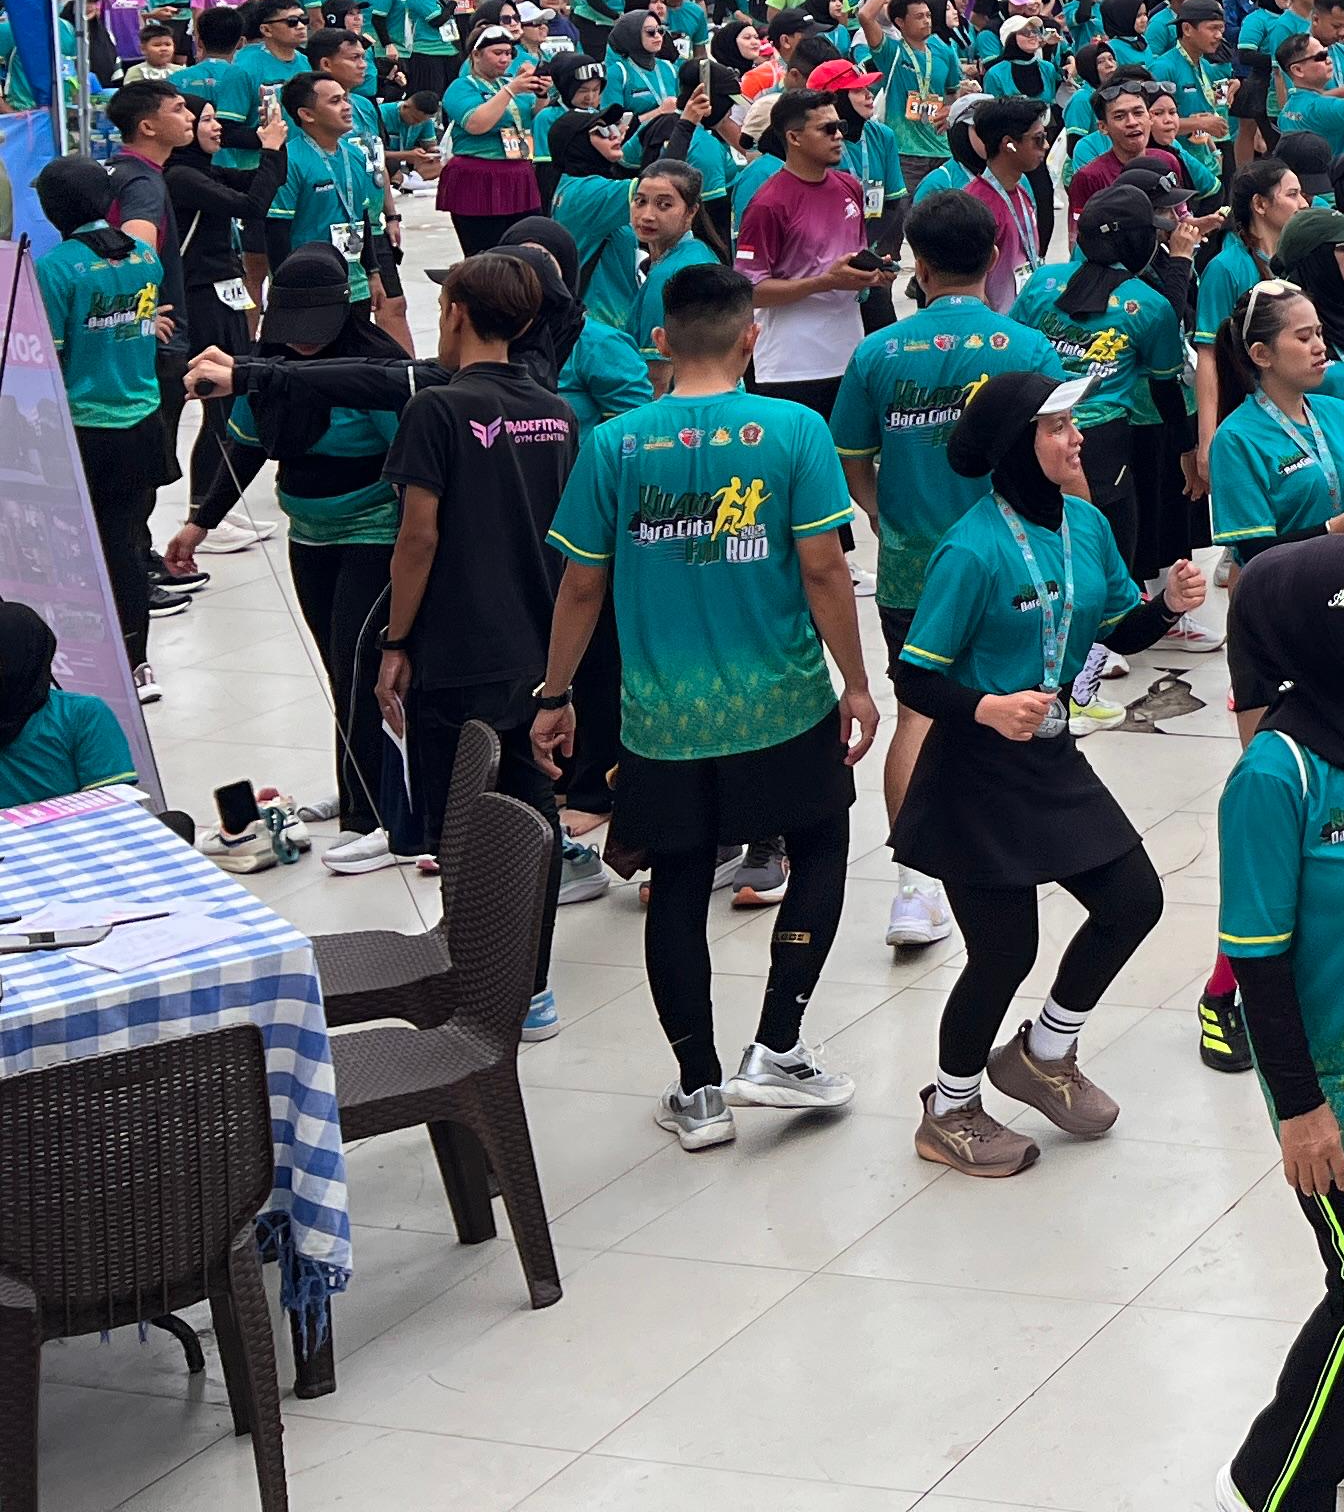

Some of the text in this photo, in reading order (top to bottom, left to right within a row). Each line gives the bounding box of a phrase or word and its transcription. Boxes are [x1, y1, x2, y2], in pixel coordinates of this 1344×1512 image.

[890, 407, 962, 427] Bara Cinta
[514, 433, 532, 445] GYM
[640, 522, 674, 541] Bara
[726, 535, 769, 563] Run
